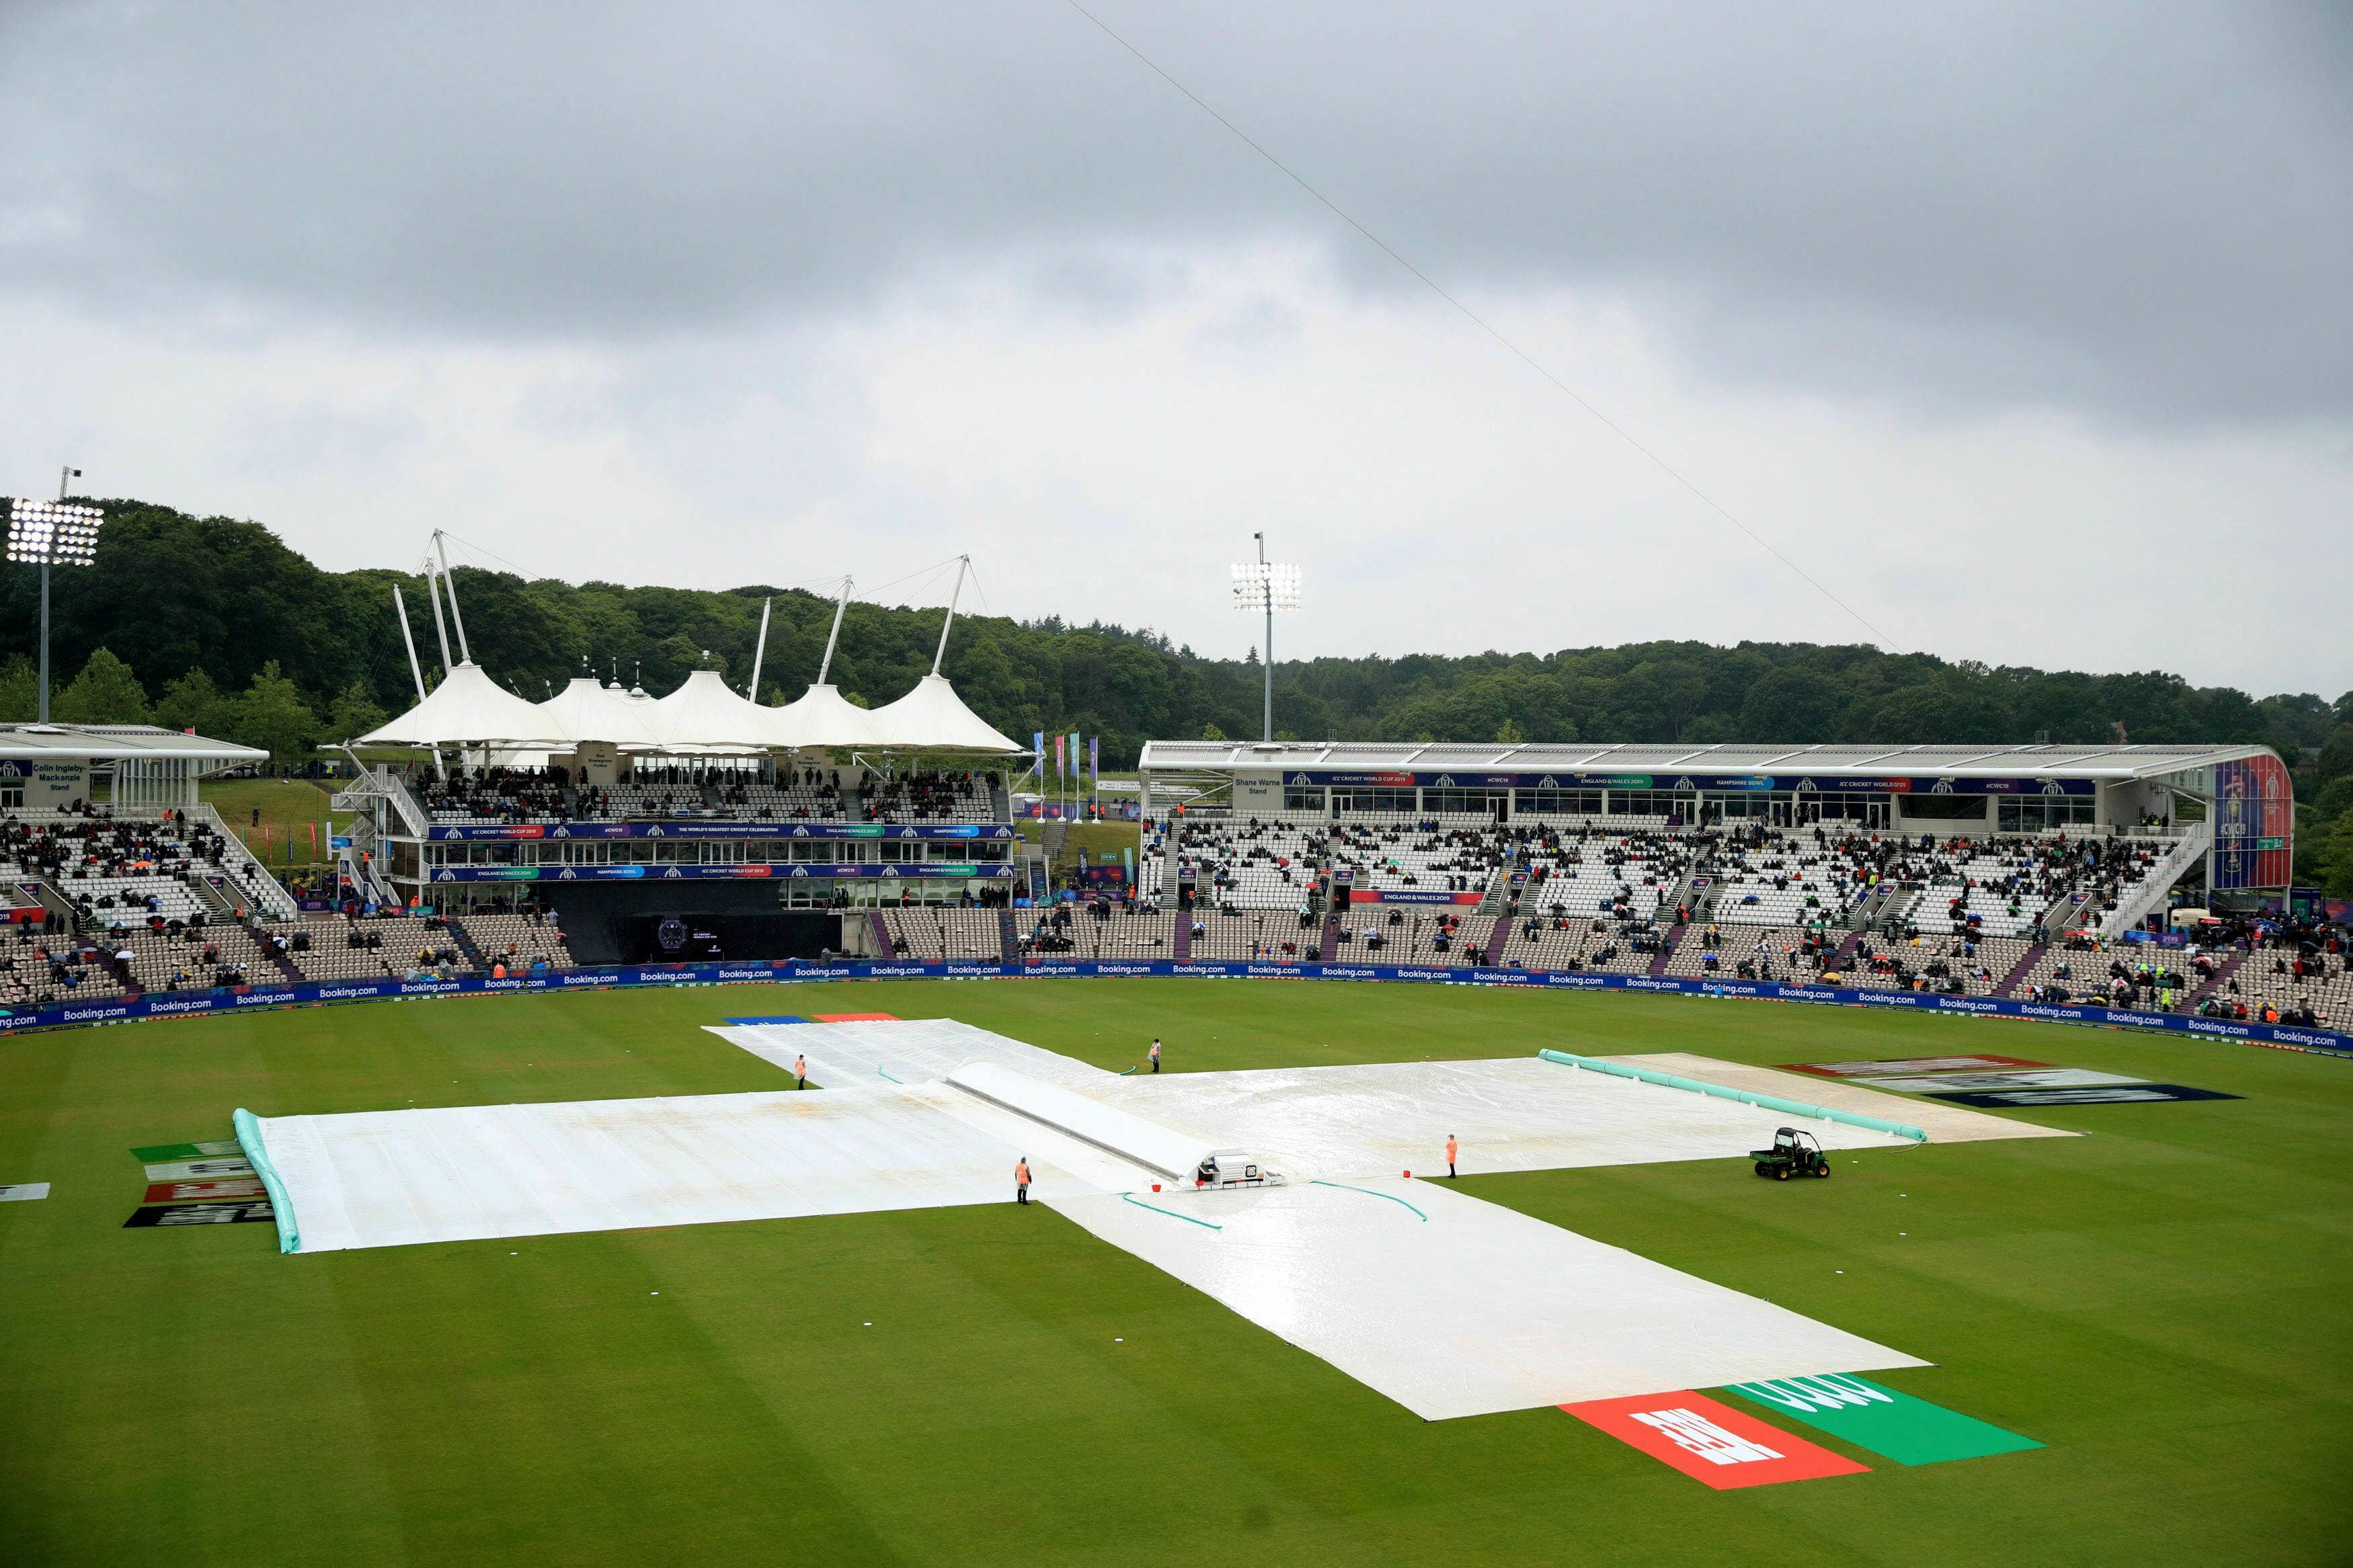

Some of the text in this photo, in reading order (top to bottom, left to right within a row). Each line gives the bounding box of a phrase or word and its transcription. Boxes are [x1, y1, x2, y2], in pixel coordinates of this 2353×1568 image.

[56, 764, 86, 773] Ingleby-
[719, 970, 772, 979] Booking.com
[795, 968, 849, 977] Booking.com
[871, 967, 924, 976] Booking.com
[947, 966, 1001, 975] Booking.com
[1025, 966, 1076, 975] Booking.com
[1098, 965, 1150, 975] Booking.com
[1173, 965, 1226, 975] Booking.com
[1248, 966, 1301, 975] Booking.com
[1322, 968, 1375, 978] Booking.com
[1398, 970, 1451, 980] Booking.com
[564, 975, 618, 985] Booking.com
[641, 973, 696, 982] Booking.com
[1474, 973, 1527, 983] Booking.com
[1549, 975, 1603, 985] Booking.com
[401, 983, 460, 993] Booking.com
[1627, 979, 1680, 990] Booking.com
[320, 988, 377, 998] Booking.com
[1779, 988, 1834, 999] Booking.com
[237, 994, 294, 1004] Booking.com
[1859, 993, 1915, 1004] Booking.com
[151, 1001, 211, 1012] Booking.com
[1940, 999, 1997, 1011] Booking.com
[64, 1008, 126, 1020] Booking.com
[2022, 1005, 2081, 1018] Booking.com
[2107, 1012, 2163, 1026] Booking.com
[2188, 1020, 2248, 1035] Booking.com
[2274, 1030, 2336, 1046] Booking.com
